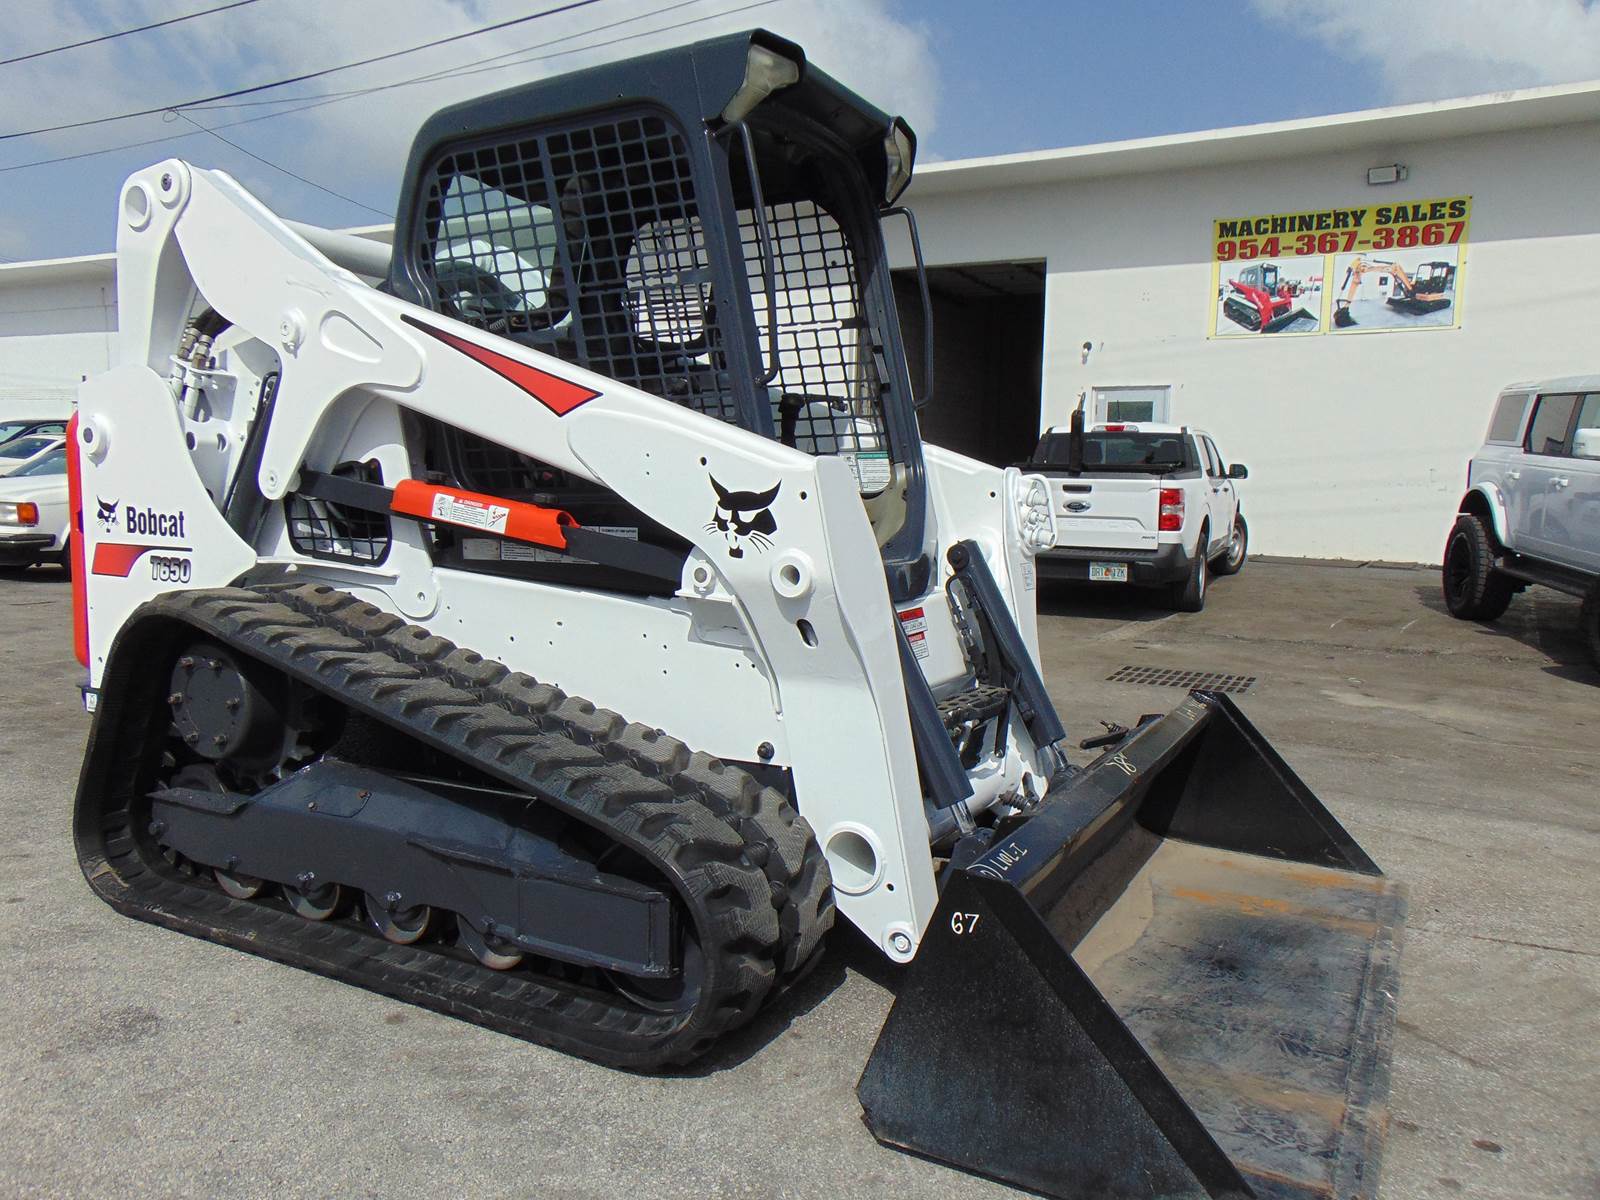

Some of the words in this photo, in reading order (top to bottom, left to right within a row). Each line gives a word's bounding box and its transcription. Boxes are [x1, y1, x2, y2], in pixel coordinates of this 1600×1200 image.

[1219, 209, 1367, 238] MACHINERY
[1376, 199, 1466, 225] SALES
[1216, 221, 1466, 261] 954-367-3867
[126, 506, 185, 538] Bobcat
[150, 555, 192, 584] T650
[951, 911, 980, 935] 67
